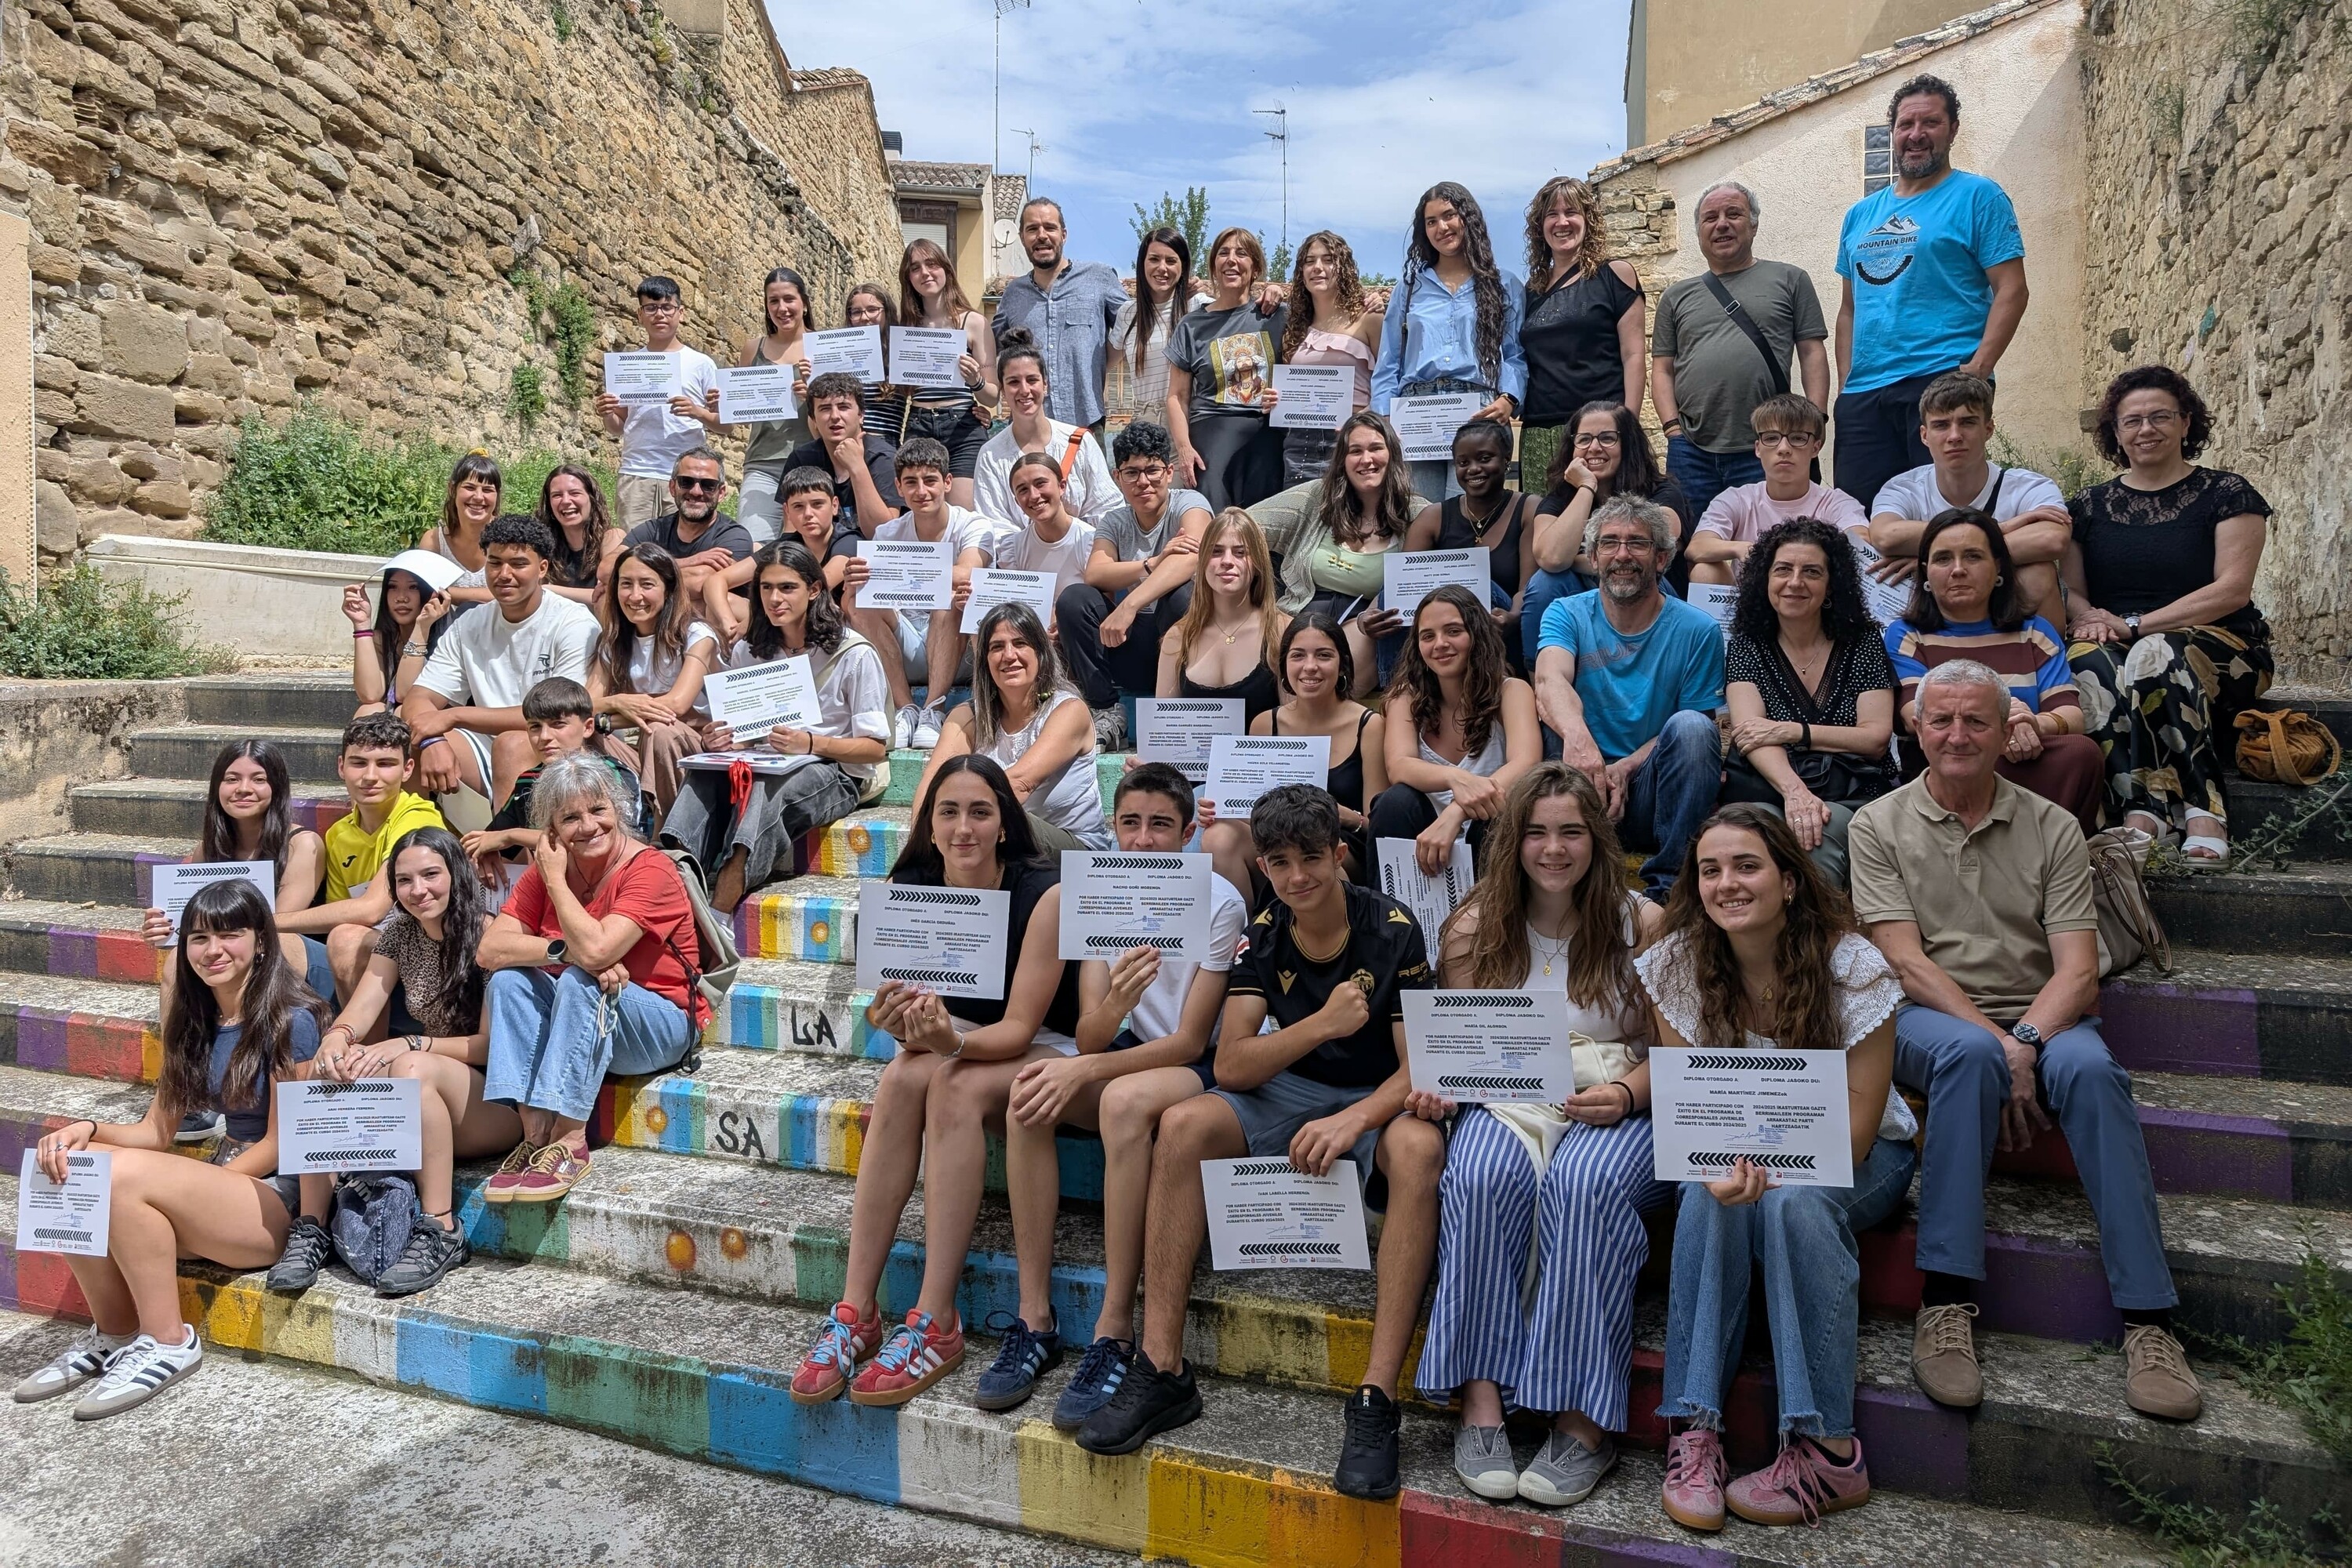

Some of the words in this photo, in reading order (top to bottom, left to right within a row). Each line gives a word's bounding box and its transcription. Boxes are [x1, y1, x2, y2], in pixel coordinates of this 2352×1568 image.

[1857, 238, 1899, 250] MOUNTAIN
[1900, 235, 1918, 244] BIKE
[791, 1005, 837, 1049] LA
[715, 1111, 766, 1159] SA
